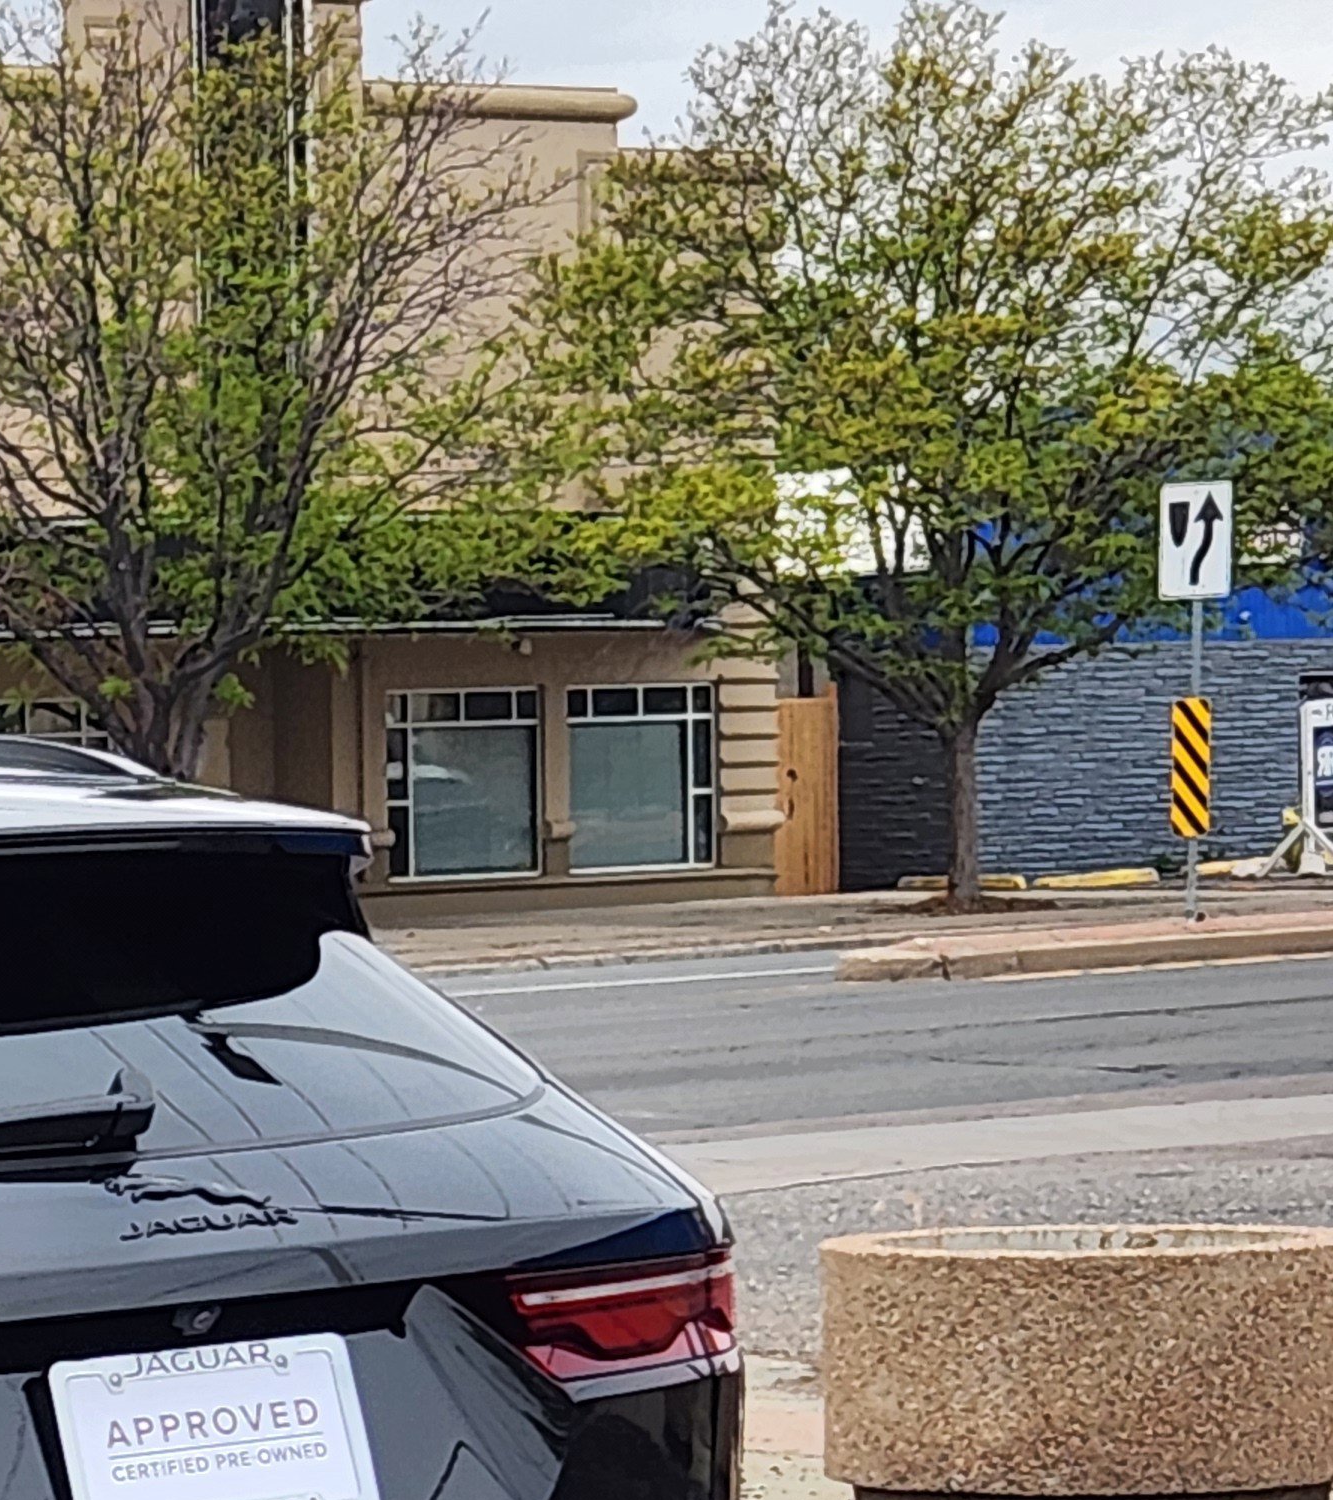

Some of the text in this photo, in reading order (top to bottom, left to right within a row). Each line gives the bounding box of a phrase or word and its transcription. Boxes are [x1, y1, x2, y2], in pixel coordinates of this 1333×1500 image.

[119, 1208, 299, 1242] JAGUAR
[123, 1342, 273, 1378] JAGUAR
[106, 1397, 319, 1449] APPROVED
[111, 1441, 328, 1483] CERTIFIED PRE-OWNED
